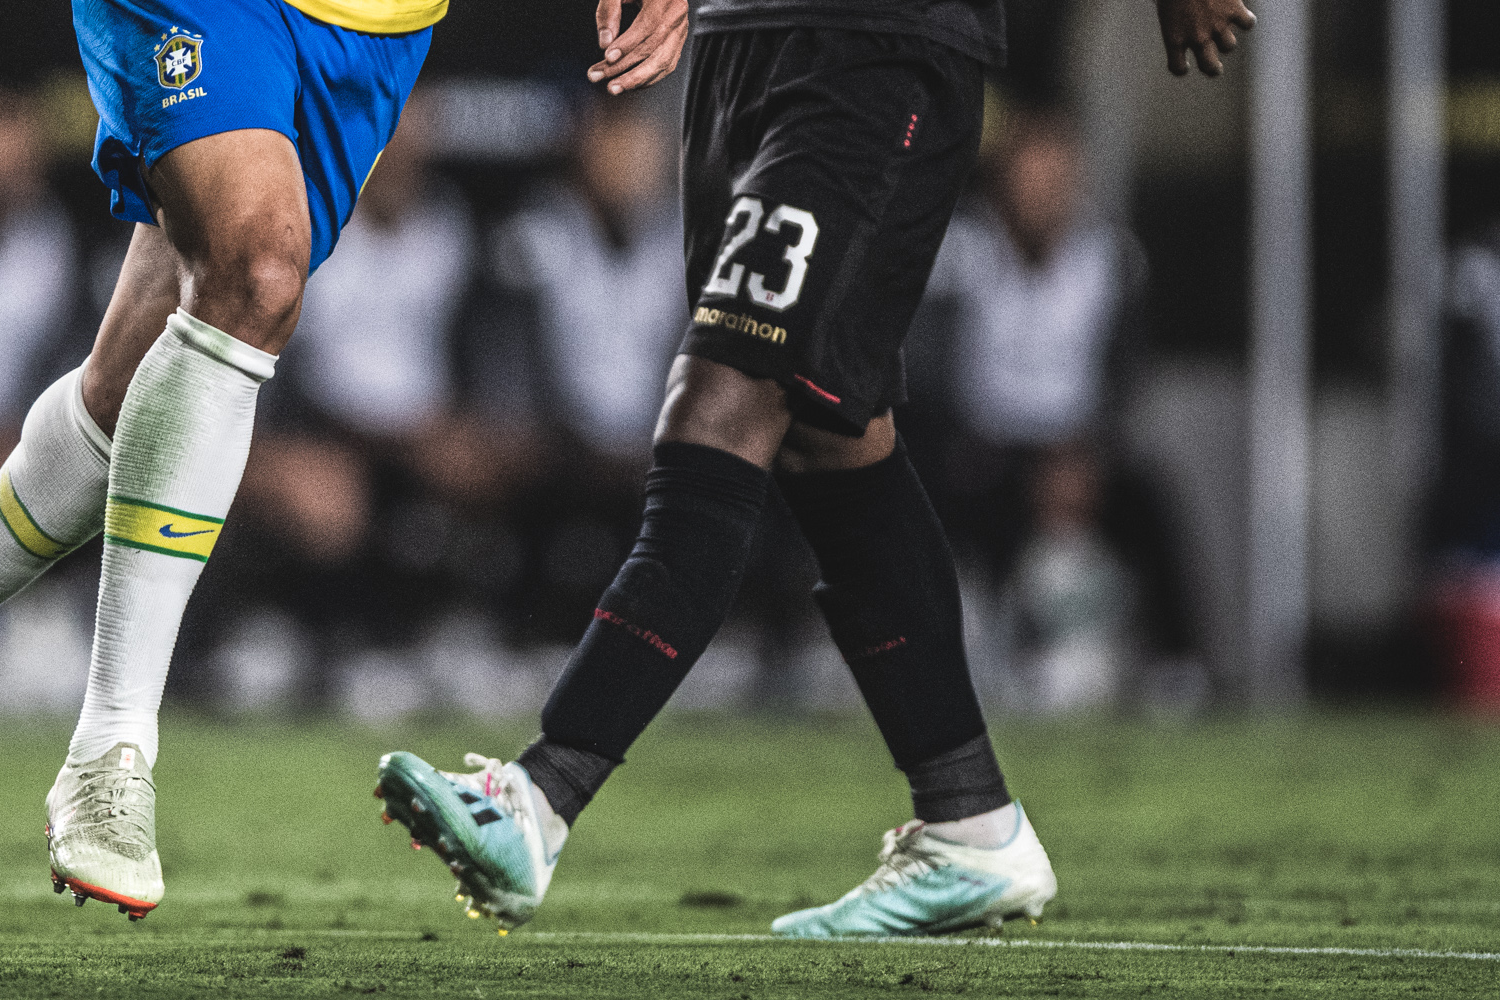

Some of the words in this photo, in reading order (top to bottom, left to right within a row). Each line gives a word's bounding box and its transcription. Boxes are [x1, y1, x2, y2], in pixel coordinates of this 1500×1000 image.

[171, 57, 187, 67] CBF
[162, 87, 207, 108] BRASIL
[703, 197, 819, 313] 23
[694, 306, 788, 345] marathon
